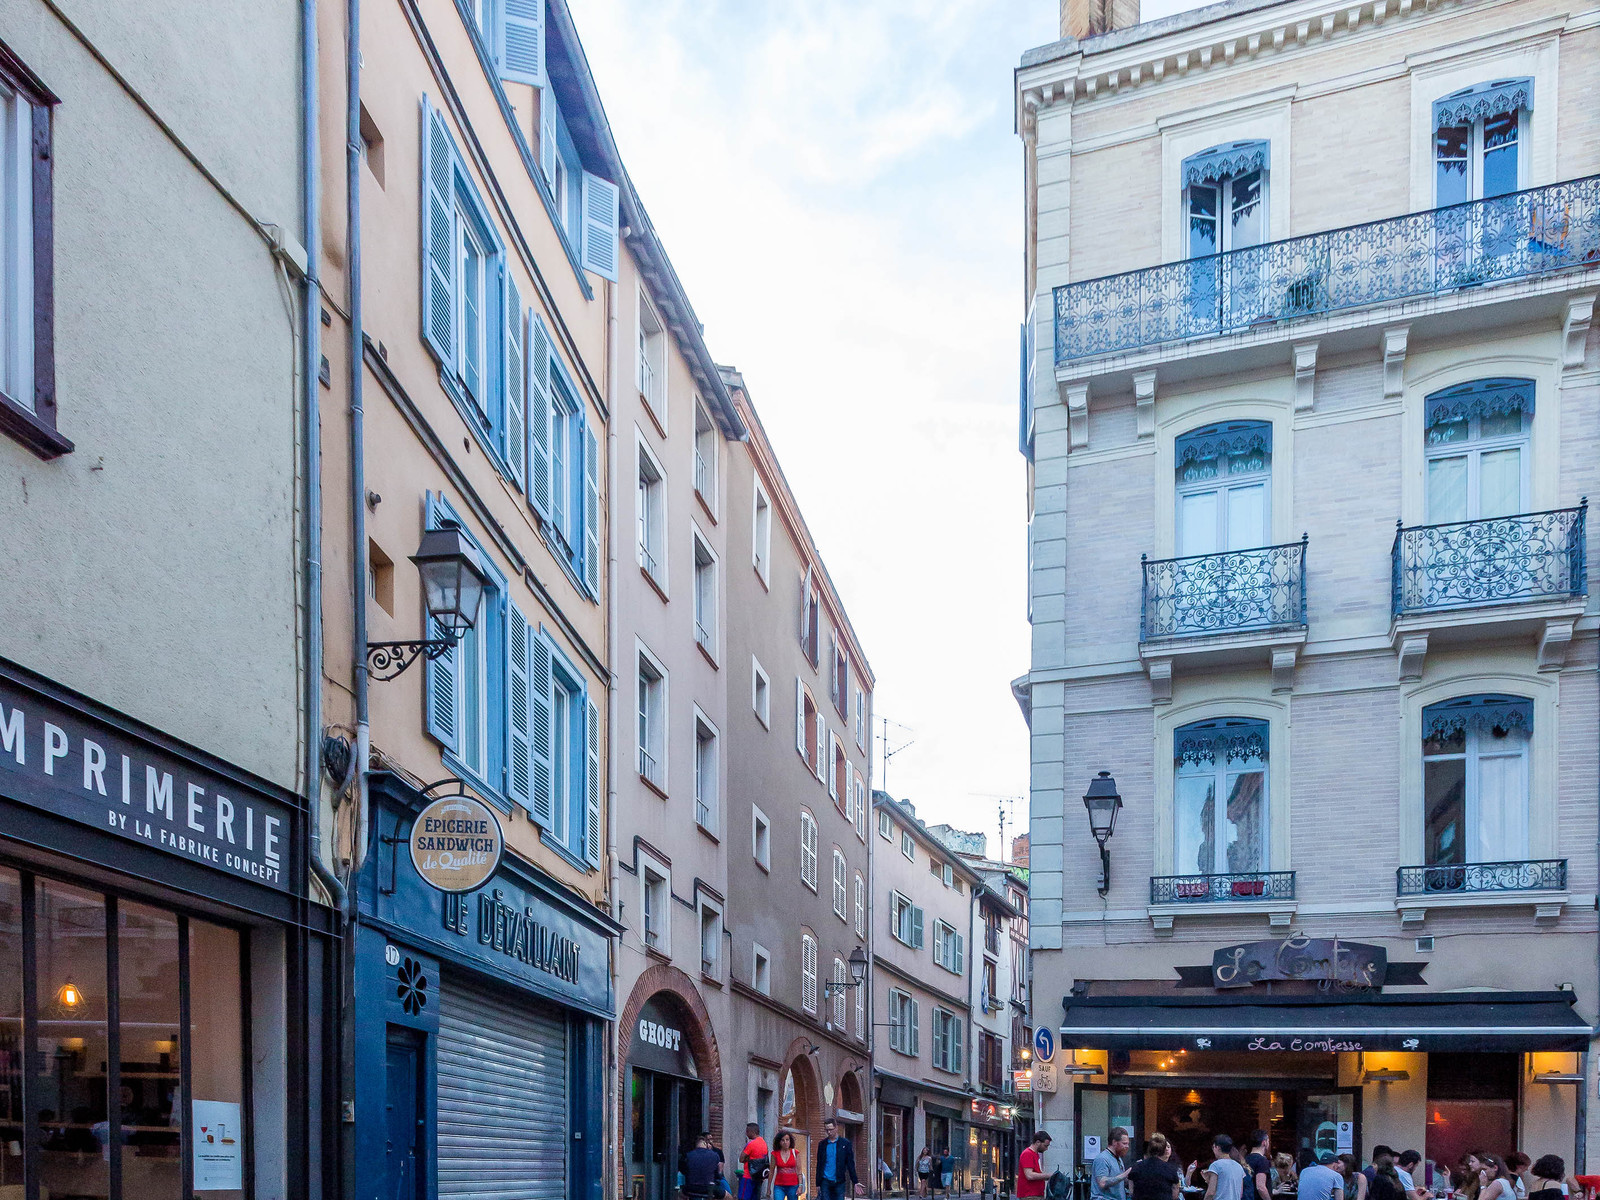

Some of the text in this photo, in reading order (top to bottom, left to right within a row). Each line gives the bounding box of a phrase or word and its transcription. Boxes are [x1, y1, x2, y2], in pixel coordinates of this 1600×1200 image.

[424, 817, 488, 834] ÉPICERIE
[108, 810, 280, 883] BY LA FABRIKE CONCEPT
[417, 836, 494, 852] SANDWICH
[422, 848, 487, 870] de Qualité
[444, 893, 469, 936] LE
[388, 946, 397, 963] 17
[639, 1019, 681, 1052] GHOST
[1247, 1037, 1363, 1051] La Comtesse
[1038, 1064, 1051, 1072] SAUF
